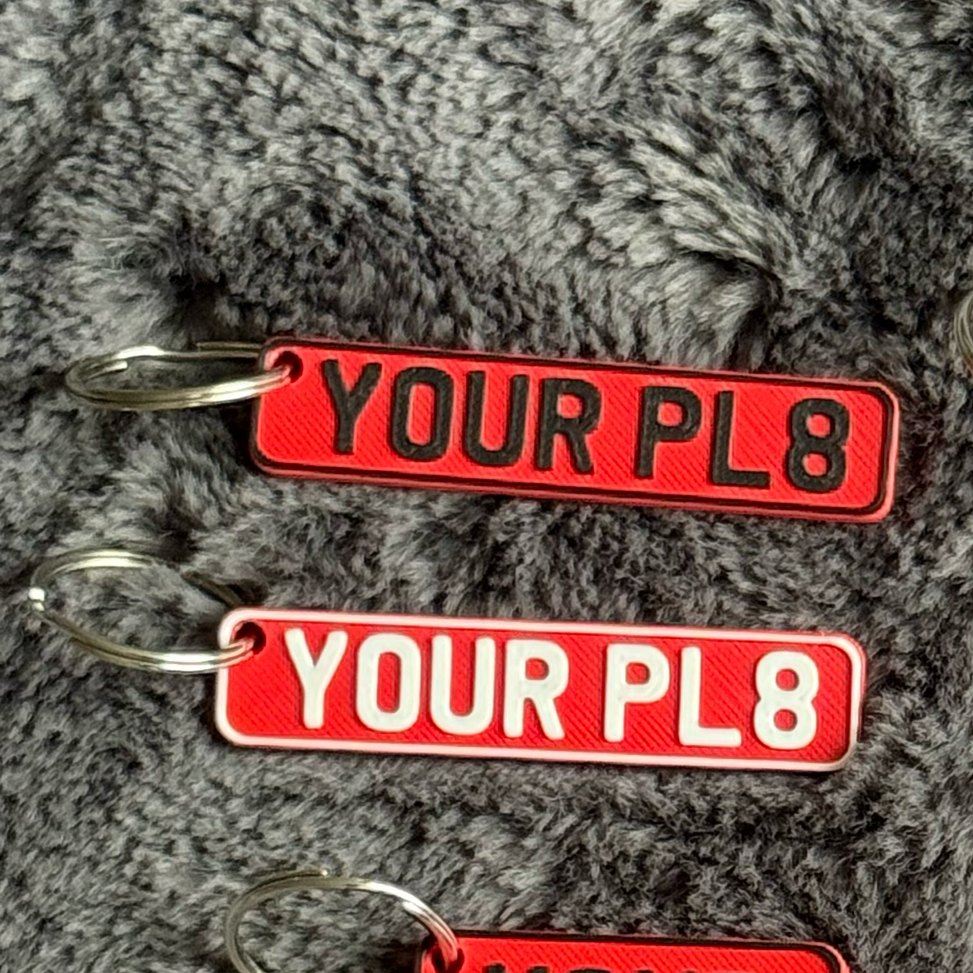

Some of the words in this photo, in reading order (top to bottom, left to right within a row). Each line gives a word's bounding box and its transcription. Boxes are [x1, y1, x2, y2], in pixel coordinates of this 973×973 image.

[323, 359, 602, 473] YOUR
[636, 385, 850, 493] PL8
[285, 627, 570, 739] YOUR
[603, 642, 820, 750] PL8
